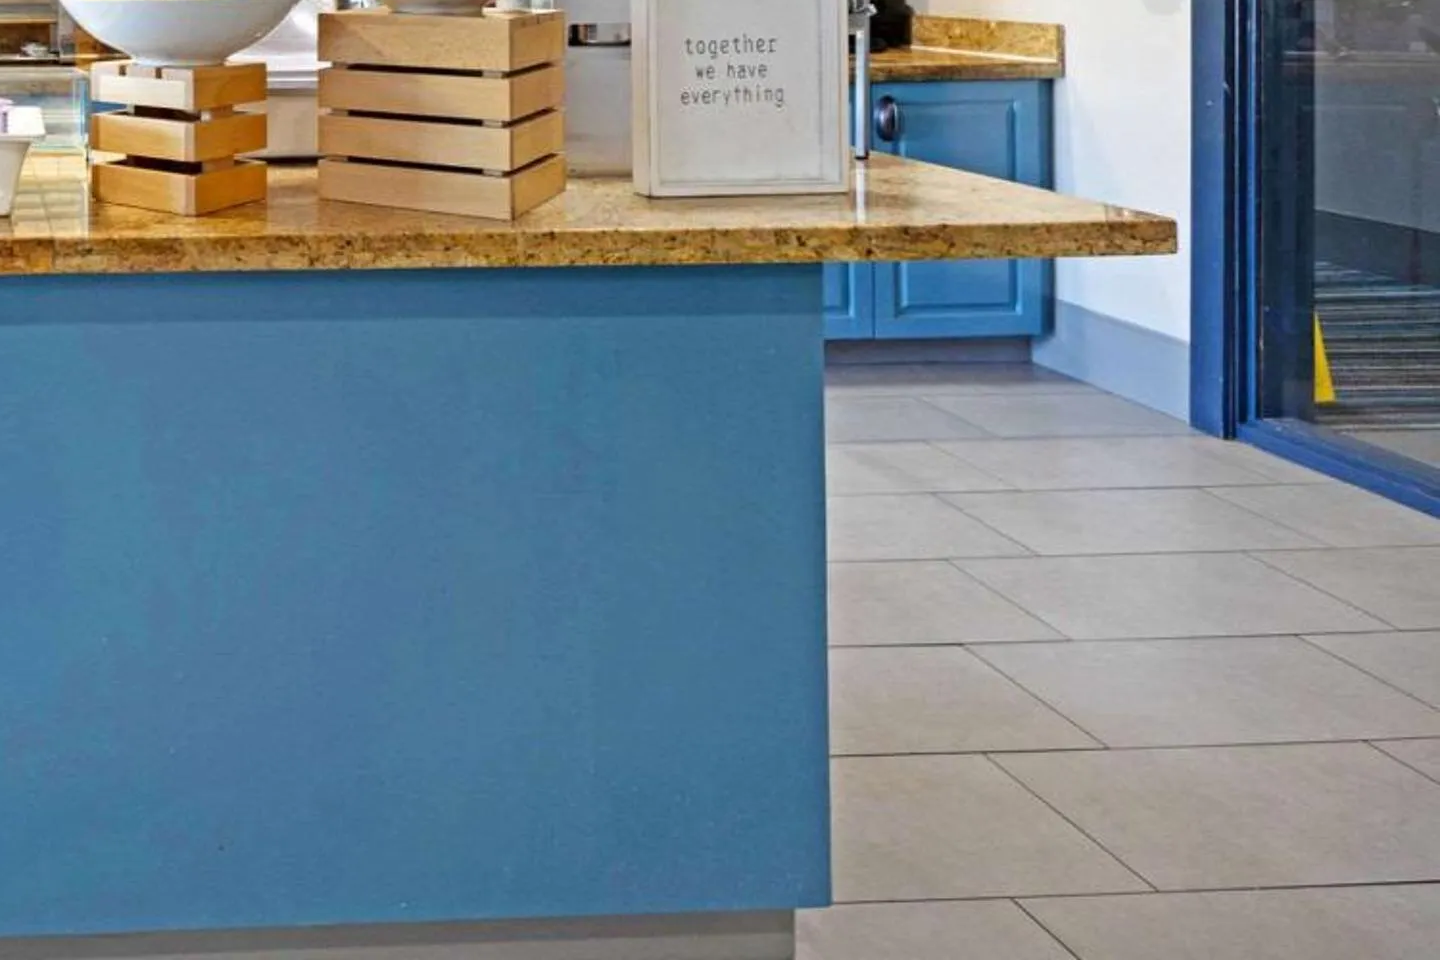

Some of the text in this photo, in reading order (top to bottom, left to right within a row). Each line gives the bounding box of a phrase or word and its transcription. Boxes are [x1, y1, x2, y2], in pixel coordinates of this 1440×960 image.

[685, 33, 777, 59] together
[695, 61, 767, 79] we have
[680, 84, 784, 108] everything
